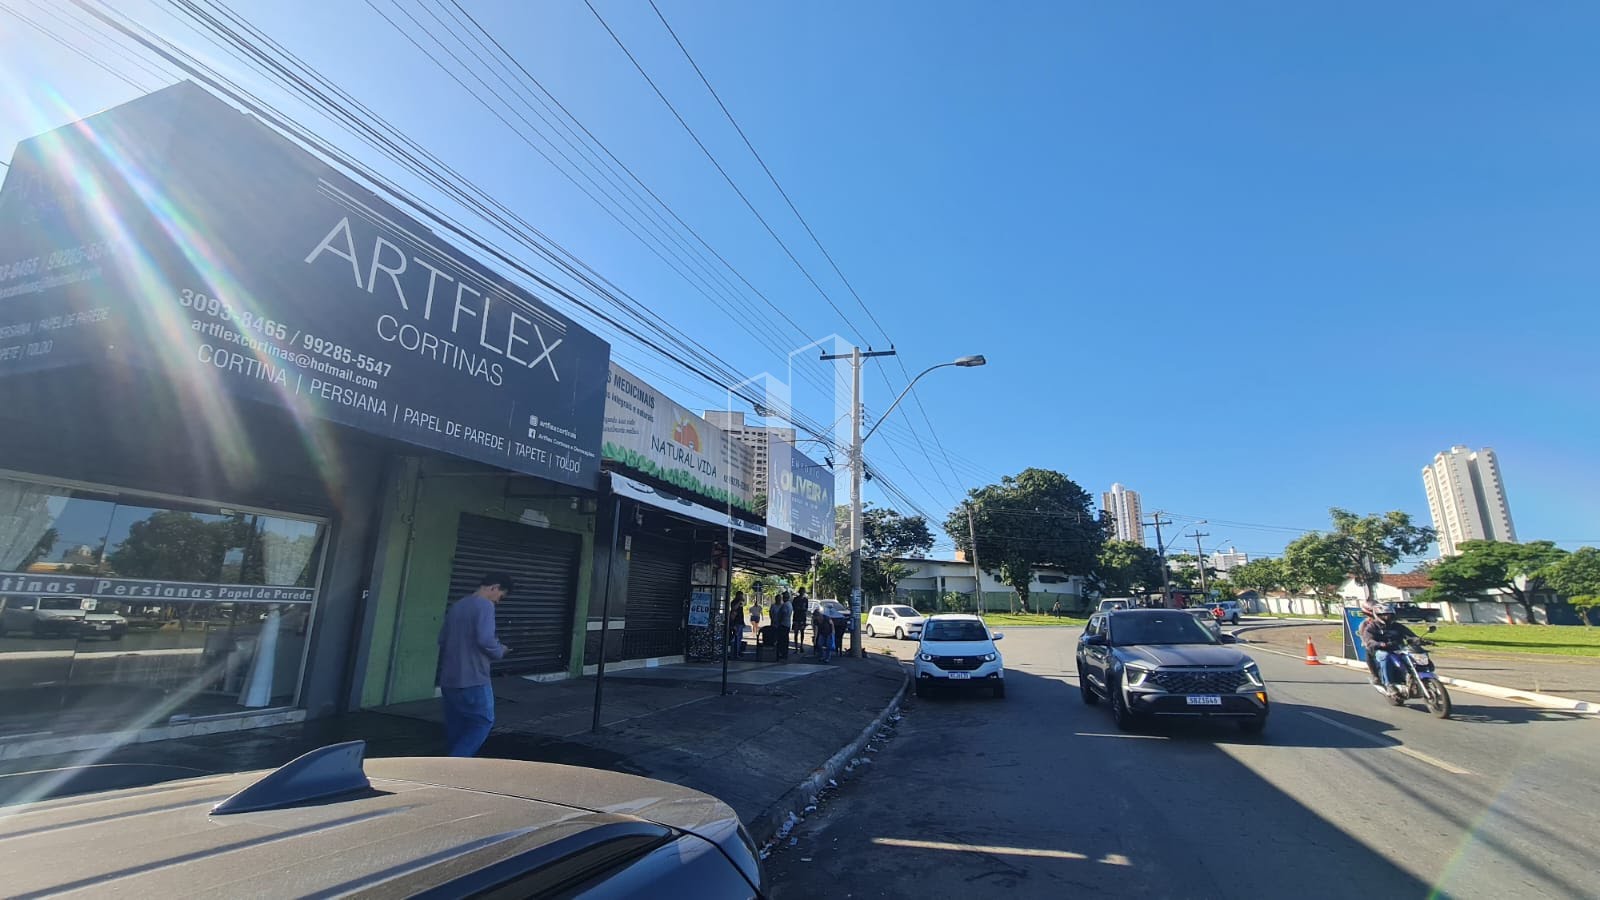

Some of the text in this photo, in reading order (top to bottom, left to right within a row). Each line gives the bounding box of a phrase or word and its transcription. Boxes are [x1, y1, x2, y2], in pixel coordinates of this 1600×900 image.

[179, 288, 288, 340] 3093-8465
[303, 334, 391, 377] 99285-5547
[304, 216, 562, 382] ARTFLEX
[191, 319, 378, 389] artflexcortinas@hotmail.com
[377, 315, 503, 386] CORTINAS
[198, 344, 287, 386] CORTINA
[310, 378, 387, 416] PERSIANA
[403, 407, 442, 433] PAPEL
[445, 421, 462, 438] DE
[463, 427, 504, 451] PAREDE
[515, 442, 547, 463] TAPETE
[556, 455, 580, 473] TOLDO
[613, 374, 655, 409] MEDICINAIS
[651, 434, 695, 468] NATURAL
[697, 458, 717, 478] VIDA
[97, 580, 213, 599] Persianas
[218, 588, 253, 601] Papel
[257, 588, 271, 599] de
[274, 589, 312, 600] Parede
